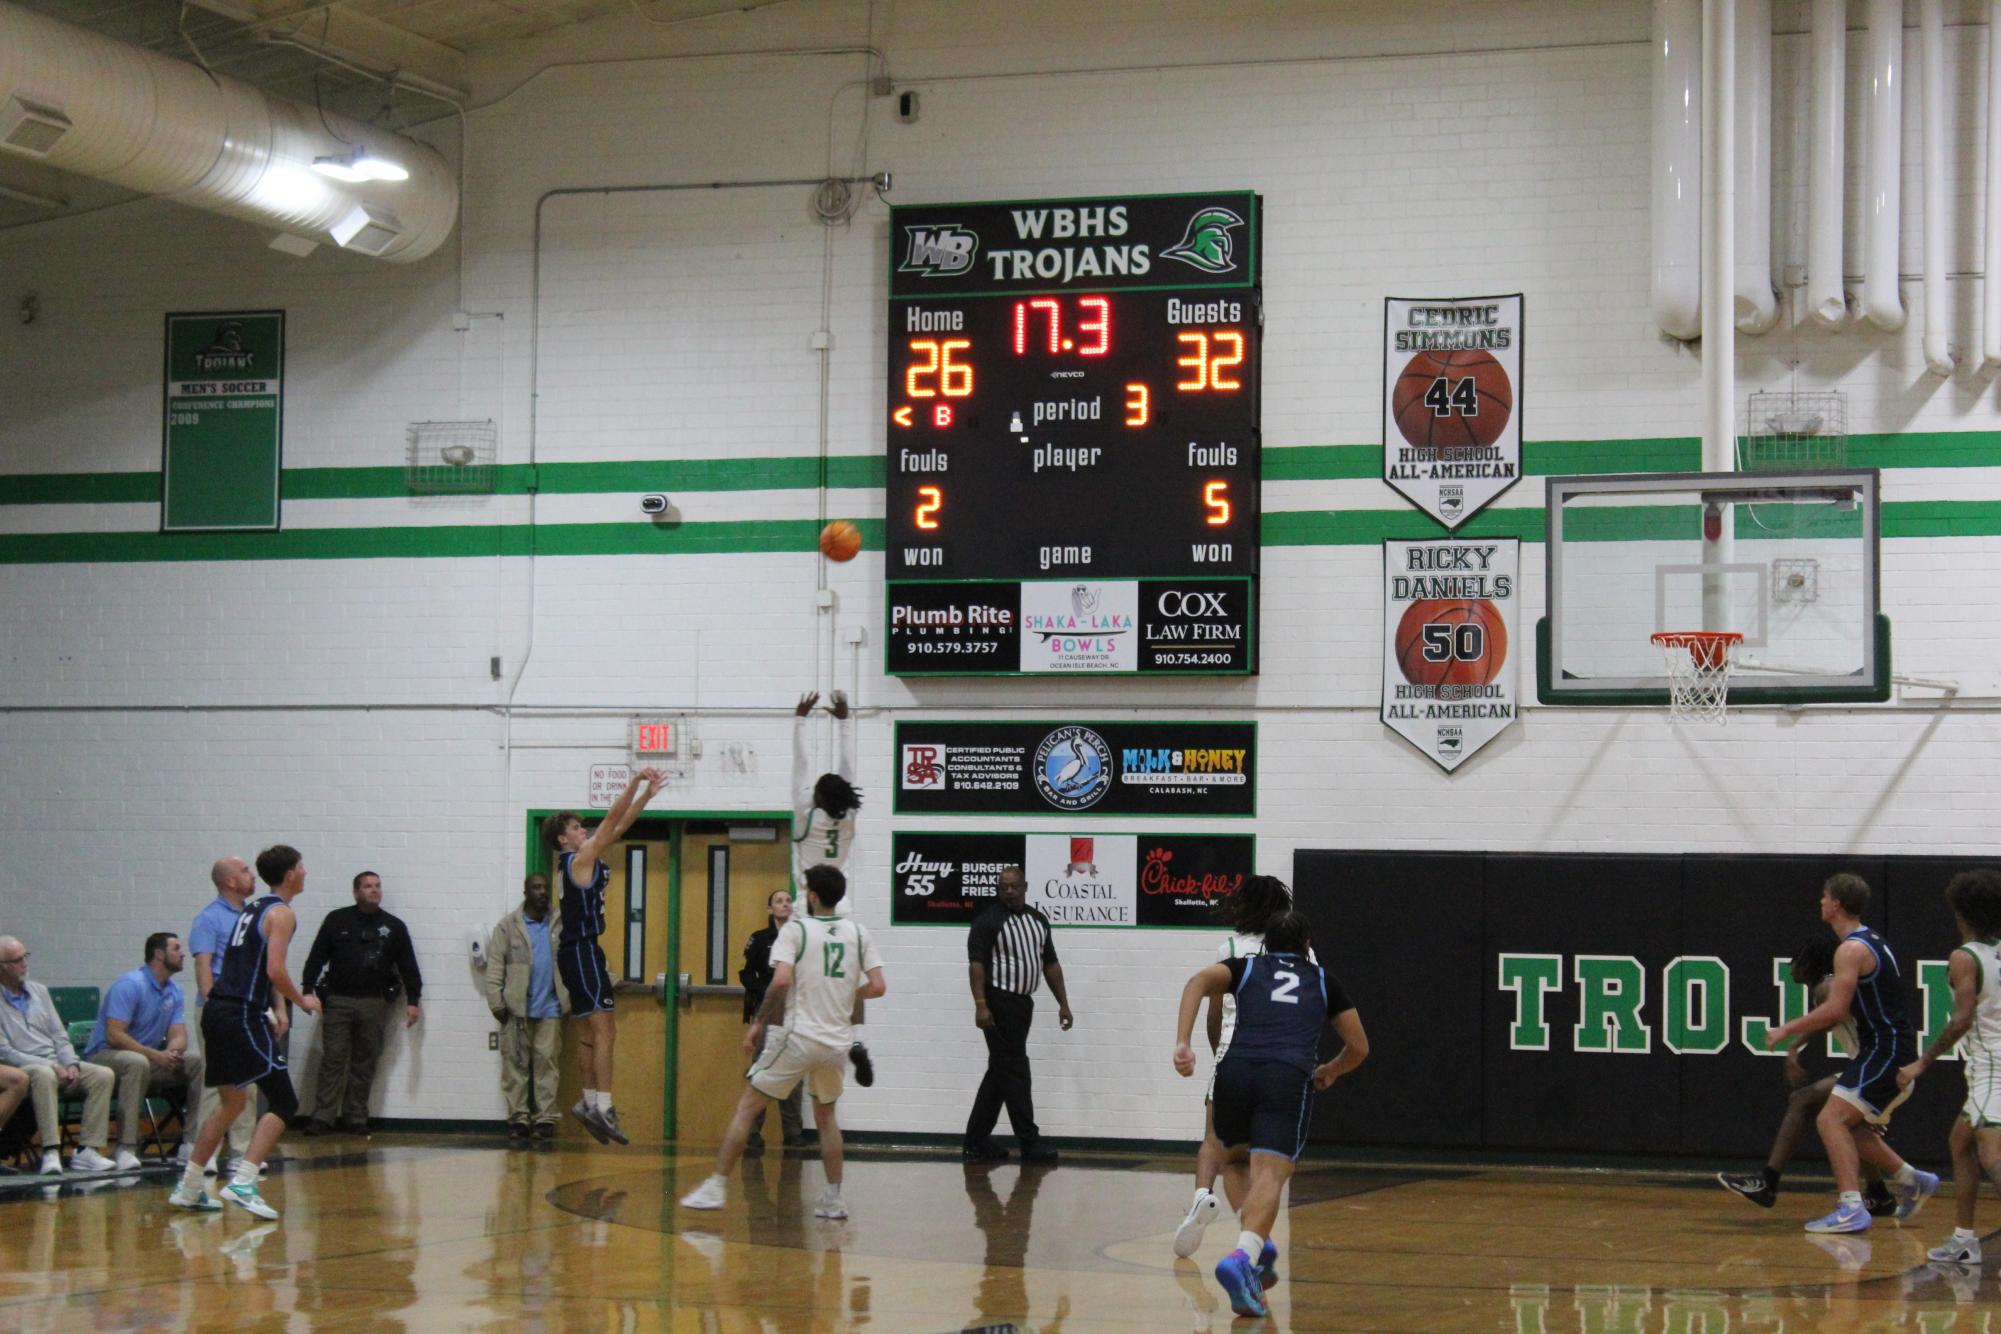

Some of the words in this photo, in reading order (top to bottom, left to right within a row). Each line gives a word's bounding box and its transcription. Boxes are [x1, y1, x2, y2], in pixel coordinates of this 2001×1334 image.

[1011, 206, 1129, 239] WBHS
[911, 229, 976, 271] WB
[987, 244, 1151, 283] TROJANS
[906, 306, 964, 332] Home
[1167, 298, 1241, 324] Guests
[1408, 305, 1499, 328] CEDRIC
[1014, 297, 1109, 355] 17.3
[1395, 328, 1511, 351] SIMMONS
[906, 339, 974, 397] 26
[1177, 332, 1244, 391] 32
[181, 383, 216, 394] MEN'S
[221, 382, 266, 393] SOCCER
[1424, 376, 1478, 417] 44
[936, 406, 951, 426] B
[1033, 396, 1101, 426] period
[1125, 384, 1148, 427] 3
[171, 413, 199, 425] 2009
[900, 448, 948, 473] fouls
[1033, 443, 1101, 472] player
[1188, 441, 1237, 467] fouls
[1399, 447, 1437, 463] HIGH
[1444, 446, 1504, 462] SCHOOL
[1389, 463, 1515, 479] ALL-AMERICAN
[916, 486, 942, 529] 2
[1204, 481, 1230, 525] 5
[904, 546, 943, 566] won
[1040, 544, 1092, 570] game
[1192, 543, 1233, 563] won
[1406, 545, 1498, 571] RICKY
[1392, 575, 1512, 601] DANIELS
[892, 605, 962, 624] Plumb
[968, 605, 1011, 624] Rite
[1158, 591, 1228, 617] COX
[1145, 624, 1188, 640] LAW
[1192, 623, 1241, 640] FIRM
[1422, 623, 1484, 662] 50
[907, 642, 998, 653] 910.579.3757
[1052, 639, 1116, 652] BOWLS
[1155, 653, 1232, 664] 910.754.2400
[1396, 685, 1437, 699] HIGH
[1440, 684, 1504, 699] SCHOOL
[1388, 704, 1512, 719] ALL-AMERICAN
[639, 724, 669, 751] EXIT
[1037, 728, 1081, 762] PELICAN'S
[1083, 731, 1109, 762] PERCH
[1122, 748, 1170, 774] MILK
[1171, 751, 1182, 766] &
[1184, 748, 1246, 774] HONEY
[592, 782, 602, 790] OR
[594, 770, 604, 778] NO
[608, 770, 627, 778] FOOD
[953, 781, 1019, 790] 910.642.2109
[1123, 775, 1178, 783] BREAKFAST
[1220, 775, 1245, 783] MORE
[1043, 785, 1058, 800] BAR
[1080, 786, 1102, 804] GRILL
[1149, 787, 1195, 795] CALABASH,
[826, 830, 838, 858] 3
[896, 851, 954, 878] Hwy
[961, 863, 1019, 873] BURGE
[904, 874, 935, 896] 55
[961, 886, 997, 896] FRIES
[962, 875, 1000, 885] SHAK
[1045, 879, 1117, 900] COASTAL
[824, 943, 845, 978] 12
[1271, 970, 1300, 1004] 2
